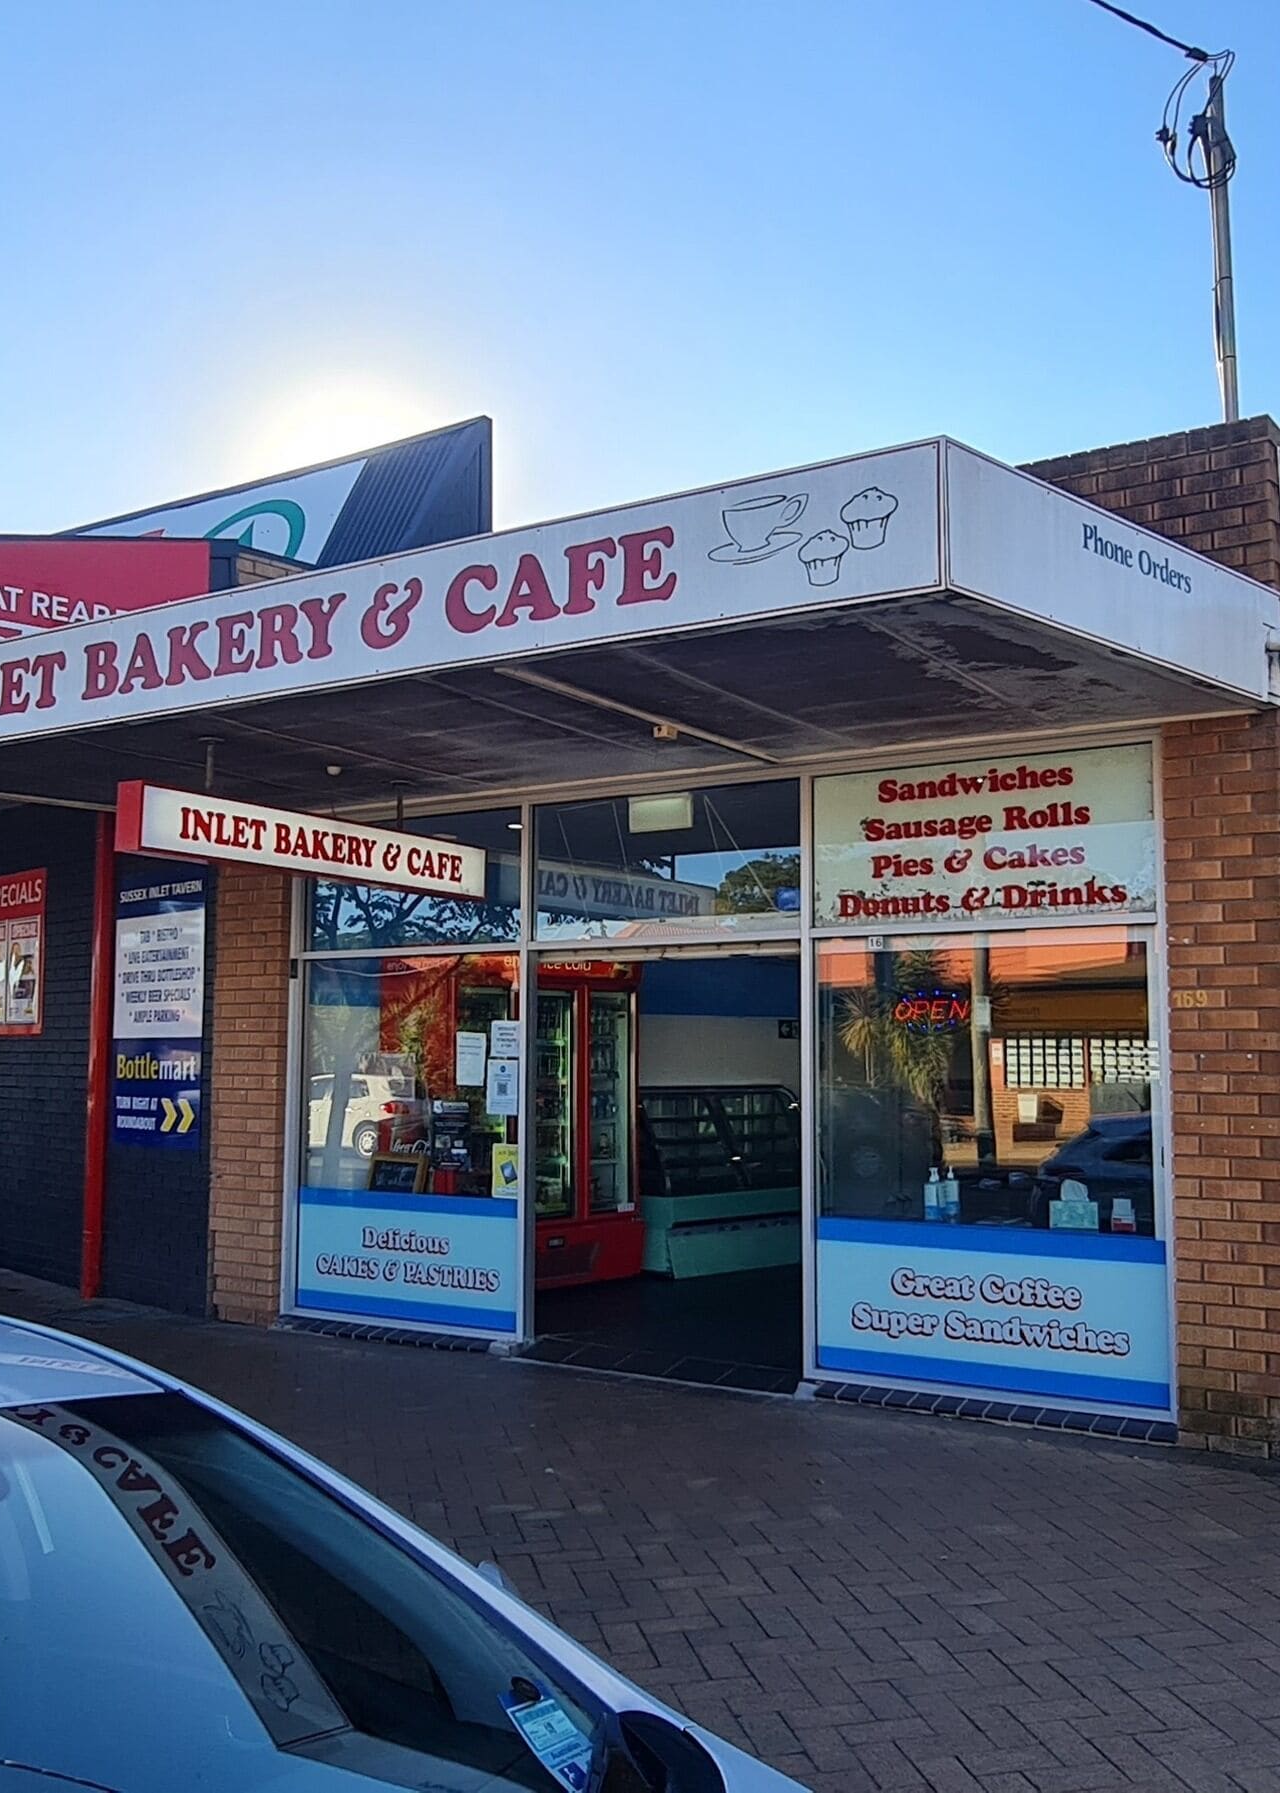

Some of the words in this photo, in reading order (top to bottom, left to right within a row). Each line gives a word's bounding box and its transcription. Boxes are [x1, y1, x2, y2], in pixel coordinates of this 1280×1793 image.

[1082, 522, 1133, 568] Phone
[1138, 550, 1192, 594] Orders
[81, 592, 347, 700] BAKERY
[360, 577, 422, 649] &
[445, 526, 678, 633] CAFE
[877, 765, 1074, 803] Sandwiches
[864, 813, 993, 842] Sausage
[1002, 801, 1091, 831] Rolls
[179, 806, 266, 850] INLET
[273, 822, 377, 868] BAKERY
[381, 843, 402, 872] &
[406, 848, 463, 883] CAFE
[871, 853, 934, 879] Pies
[943, 849, 973, 873] &
[982, 843, 1086, 871] Cakes
[119, 887, 148, 904] SUSSEX
[149, 883, 171, 900] INLET
[171, 879, 203, 896] TAVERN
[837, 890, 950, 918] Donuts
[961, 886, 991, 912] &
[1001, 878, 1128, 909] Drinks
[895, 1000, 969, 1020] OPEN
[1173, 990, 1208, 1008] 169
[116, 1051, 197, 1081] Bottlemart
[361, 1226, 450, 1255] Delicious
[316, 1252, 381, 1281] CAKES
[383, 1258, 400, 1282] &
[403, 1260, 501, 1292] PASTRIES
[890, 1266, 975, 1301] Great
[979, 1273, 1083, 1310] Coffee
[851, 1301, 940, 1339] Super
[944, 1309, 1131, 1356] Sandwiches
